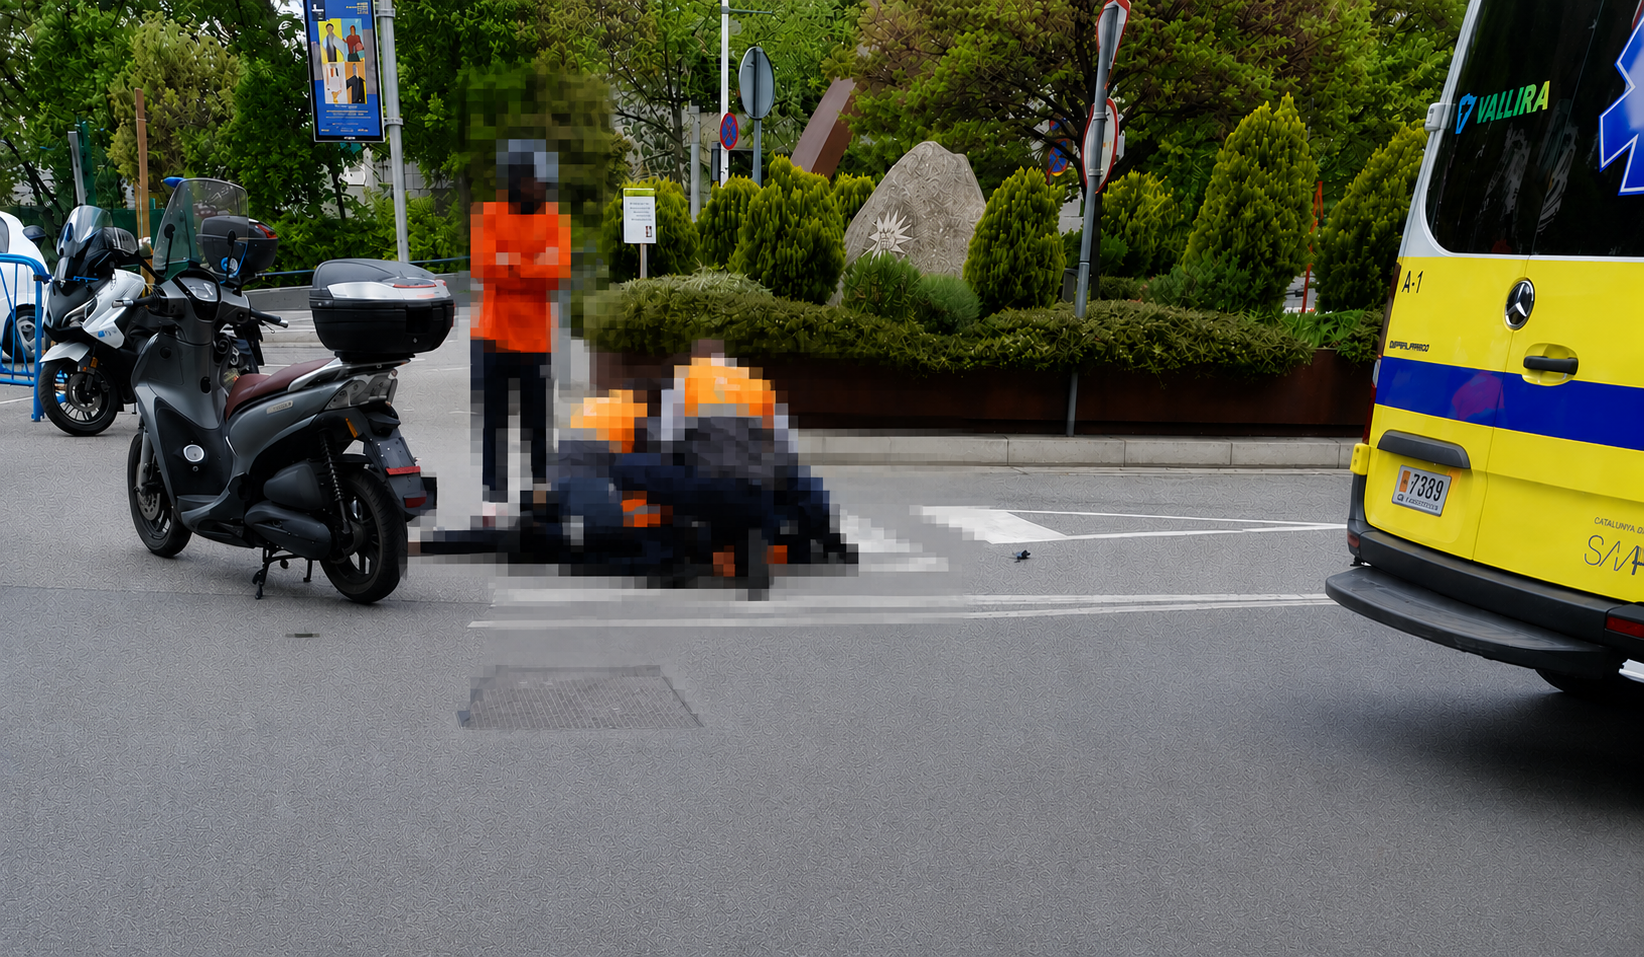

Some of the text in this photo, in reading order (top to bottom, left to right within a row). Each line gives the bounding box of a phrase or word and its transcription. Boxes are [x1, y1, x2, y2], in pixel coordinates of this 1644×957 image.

[1476, 80, 1550, 124] VALLIRA
[1409, 473, 1444, 502] 7389
[1594, 516, 1635, 533] CATALUNYA
